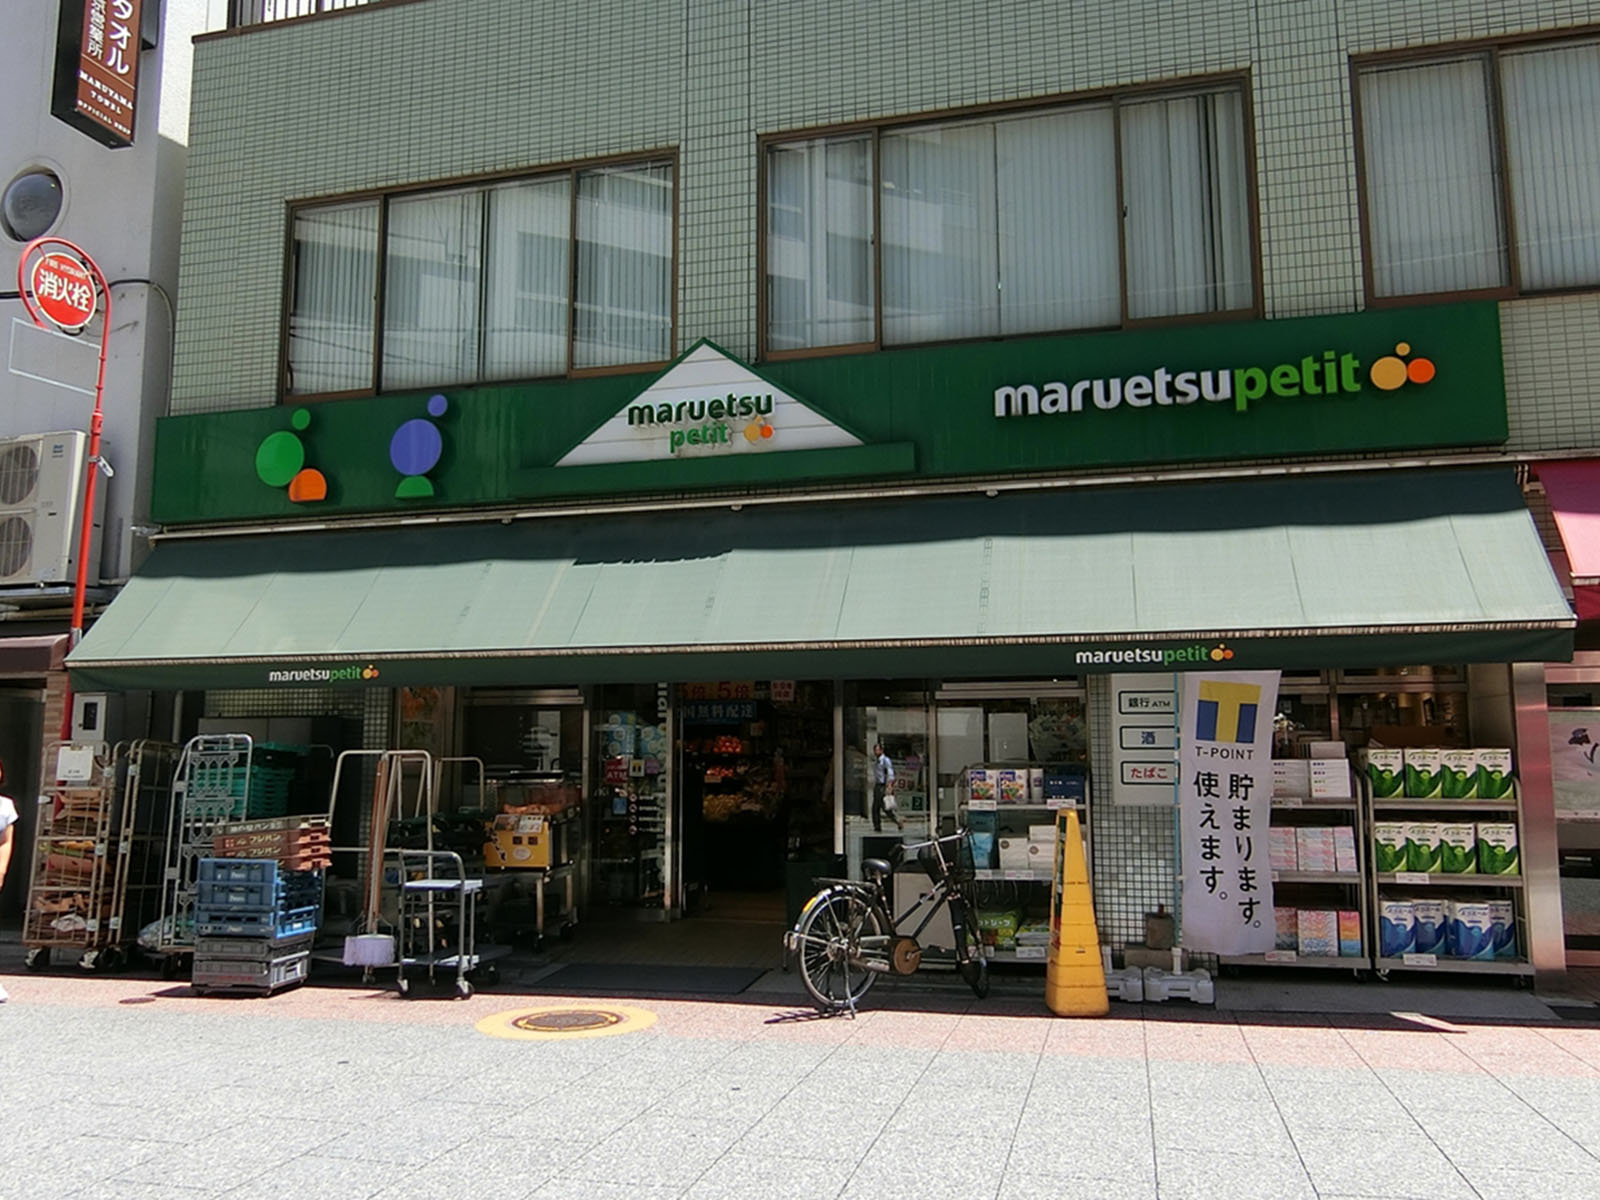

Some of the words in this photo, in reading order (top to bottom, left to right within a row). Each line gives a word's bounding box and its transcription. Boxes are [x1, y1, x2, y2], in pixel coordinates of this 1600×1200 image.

[107, 0, 133, 75] タオル
[79, 69, 133, 110] MARUYAMA
[90, 90, 122, 114] TOWEL
[38, 267, 92, 312] 消火栓
[628, 393, 773, 425] maruetsu
[669, 422, 729, 453] petit
[1151, 700, 1170, 708] ATM
[1141, 731, 1155, 745] 酒
[1195, 746, 1254, 760] T-POINT
[1130, 767, 1168, 779] たばこ
[1193, 771, 1228, 900] 使えます。
[1228, 773, 1262, 928] 貯まります。
